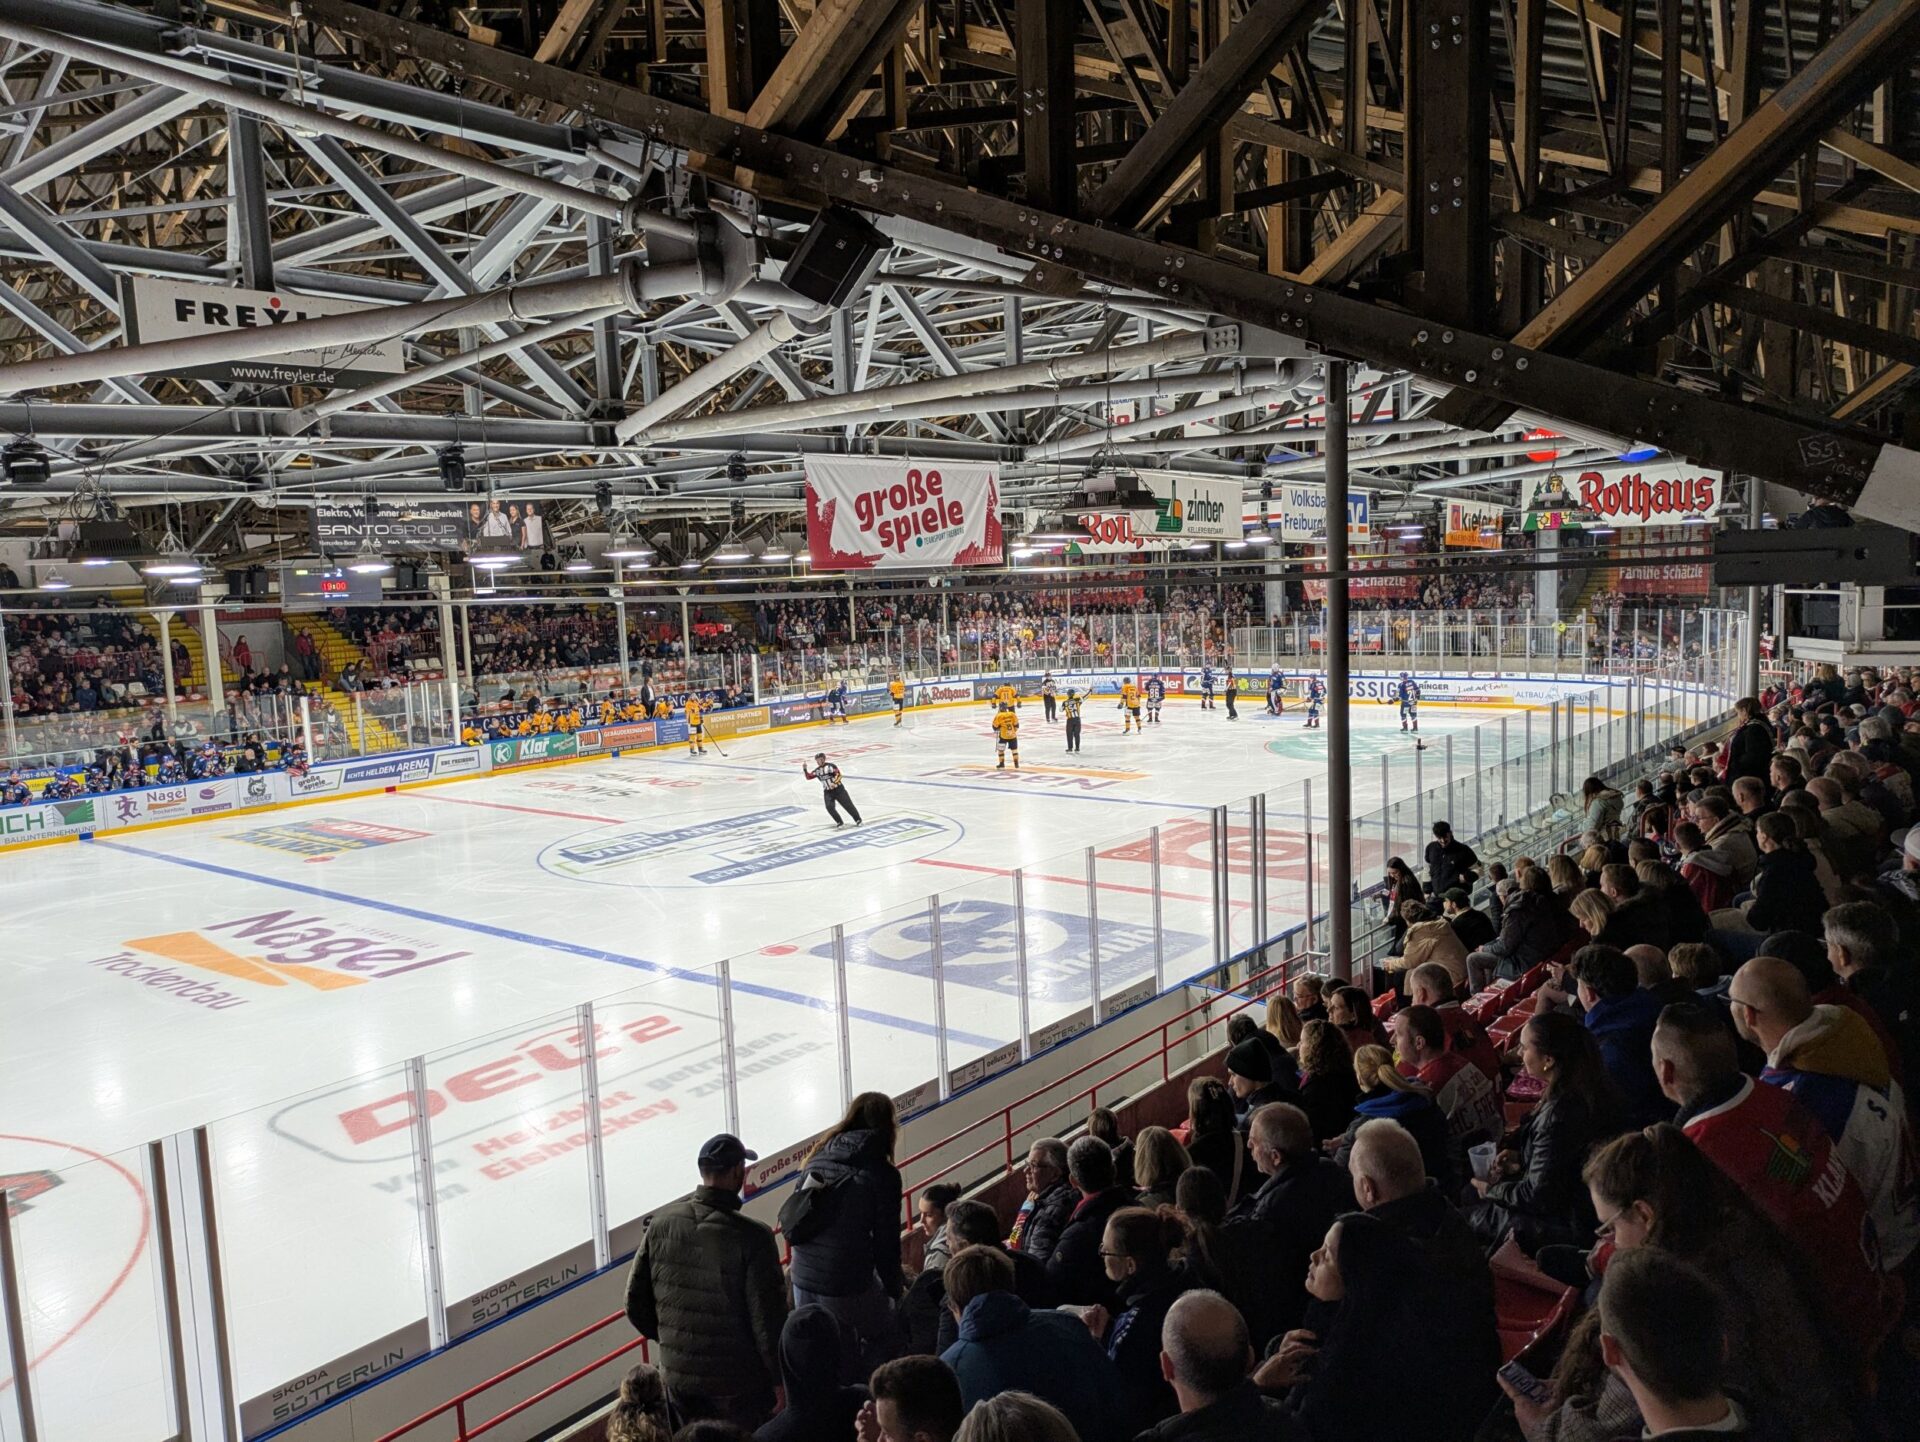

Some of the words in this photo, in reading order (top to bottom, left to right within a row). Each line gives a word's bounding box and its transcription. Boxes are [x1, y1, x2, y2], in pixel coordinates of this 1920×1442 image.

[231, 366, 335, 384] www.freyler.de
[854, 468, 943, 532] große
[1187, 489, 1224, 523] zimber
[1291, 489, 1326, 508] Volksba
[1578, 471, 1715, 522] Rothaus
[317, 509, 352, 518] Elektro,
[421, 510, 463, 518] Sauberkeit
[317, 525, 457, 536] SANTOGROUP
[877, 496, 964, 553] spiele
[322, 581, 347, 591] 19:00
[931, 686, 971, 702] Rothaus
[366, 765, 395, 777] HELDEN
[396, 758, 430, 772] ARENA
[297, 775, 321, 788] große
[303, 780, 326, 791] spiele
[147, 788, 187, 803] Nagel
[4, 825, 97, 845] BAUUNTERNEHMUNG
[757, 842, 839, 871] HELDEN
[840, 819, 917, 847] ARENA
[202, 909, 474, 979] Nagel
[88, 951, 248, 1011] Trockenbau
[480, 1098, 680, 1181] Eishockey
[759, 1157, 791, 1184] große
